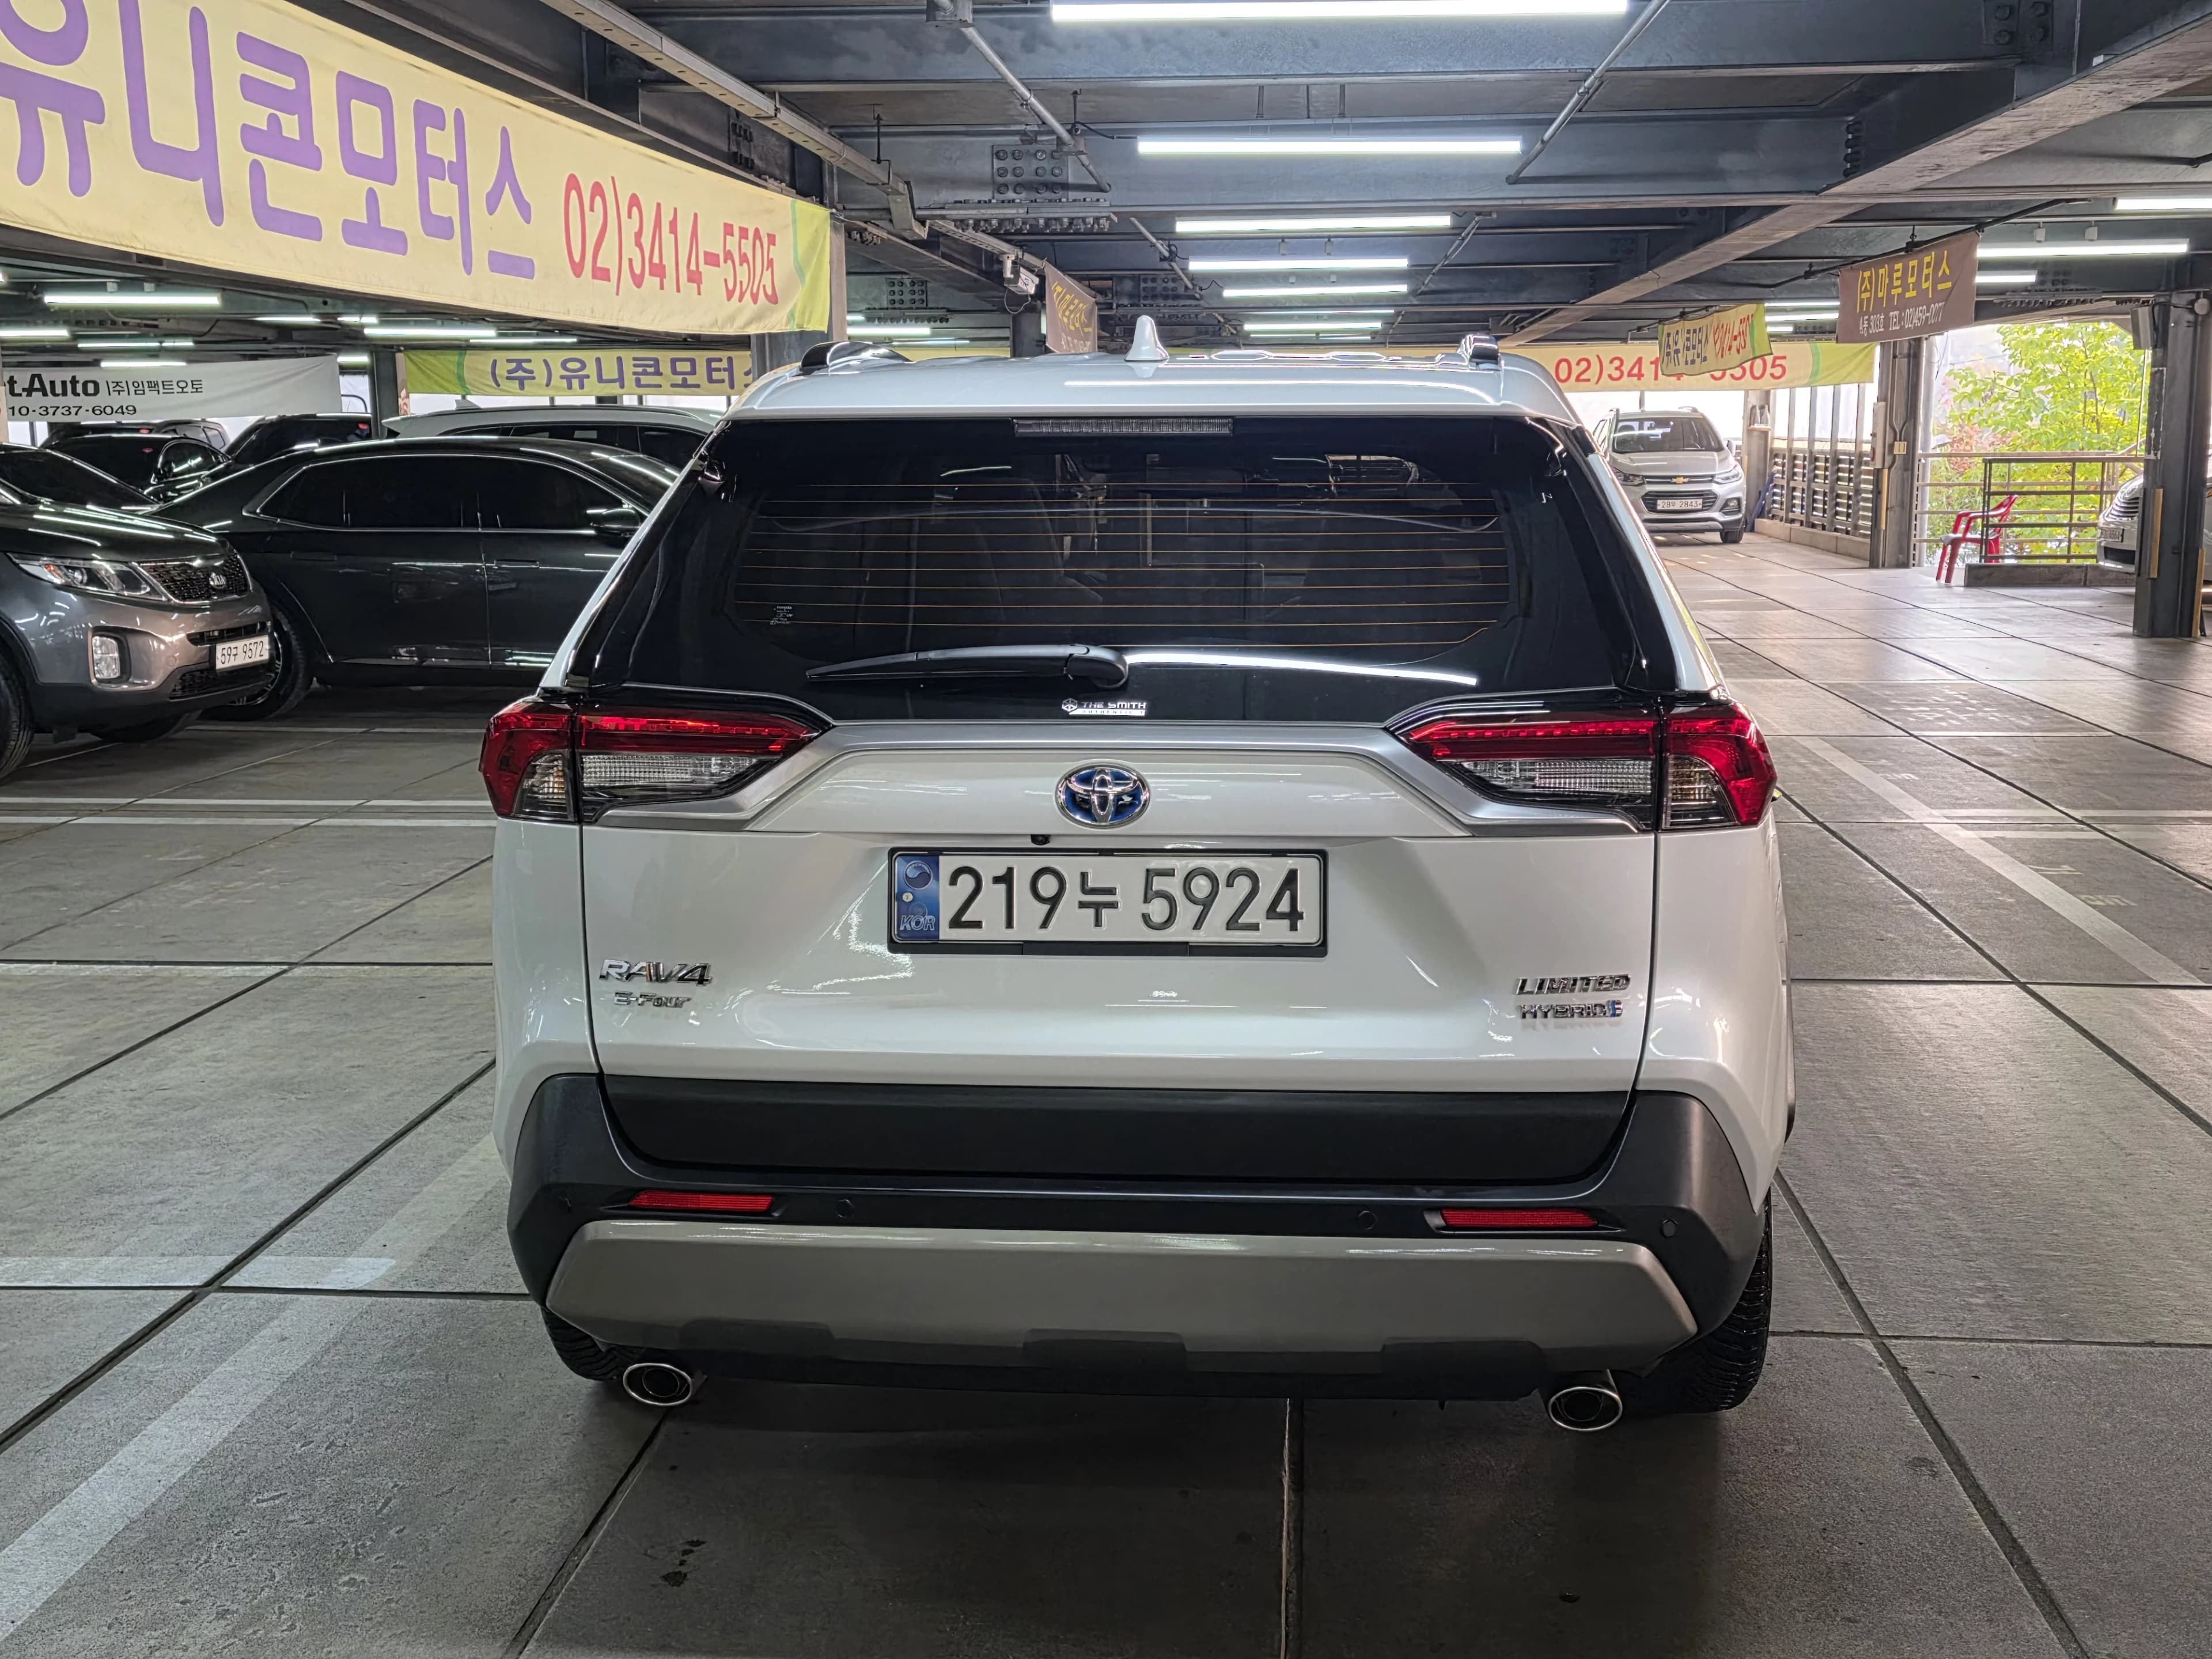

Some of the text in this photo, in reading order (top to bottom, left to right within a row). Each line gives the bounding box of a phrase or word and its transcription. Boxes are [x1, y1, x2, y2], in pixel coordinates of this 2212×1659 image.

[0, 0, 779, 305] 유니콘모터스 02)3414-5505
[1857, 250, 1952, 313] (주)마루모터스
[1555, 354, 1787, 385] 02)34105
[221, 640, 264, 664] 59구 9572
[948, 865, 1305, 933] 219누 5924
[900, 915, 936, 931] KOR
[599, 959, 713, 987] RAV4
[1516, 974, 1631, 995] LIMITED
[1521, 1002, 1607, 1019] HYBRID
